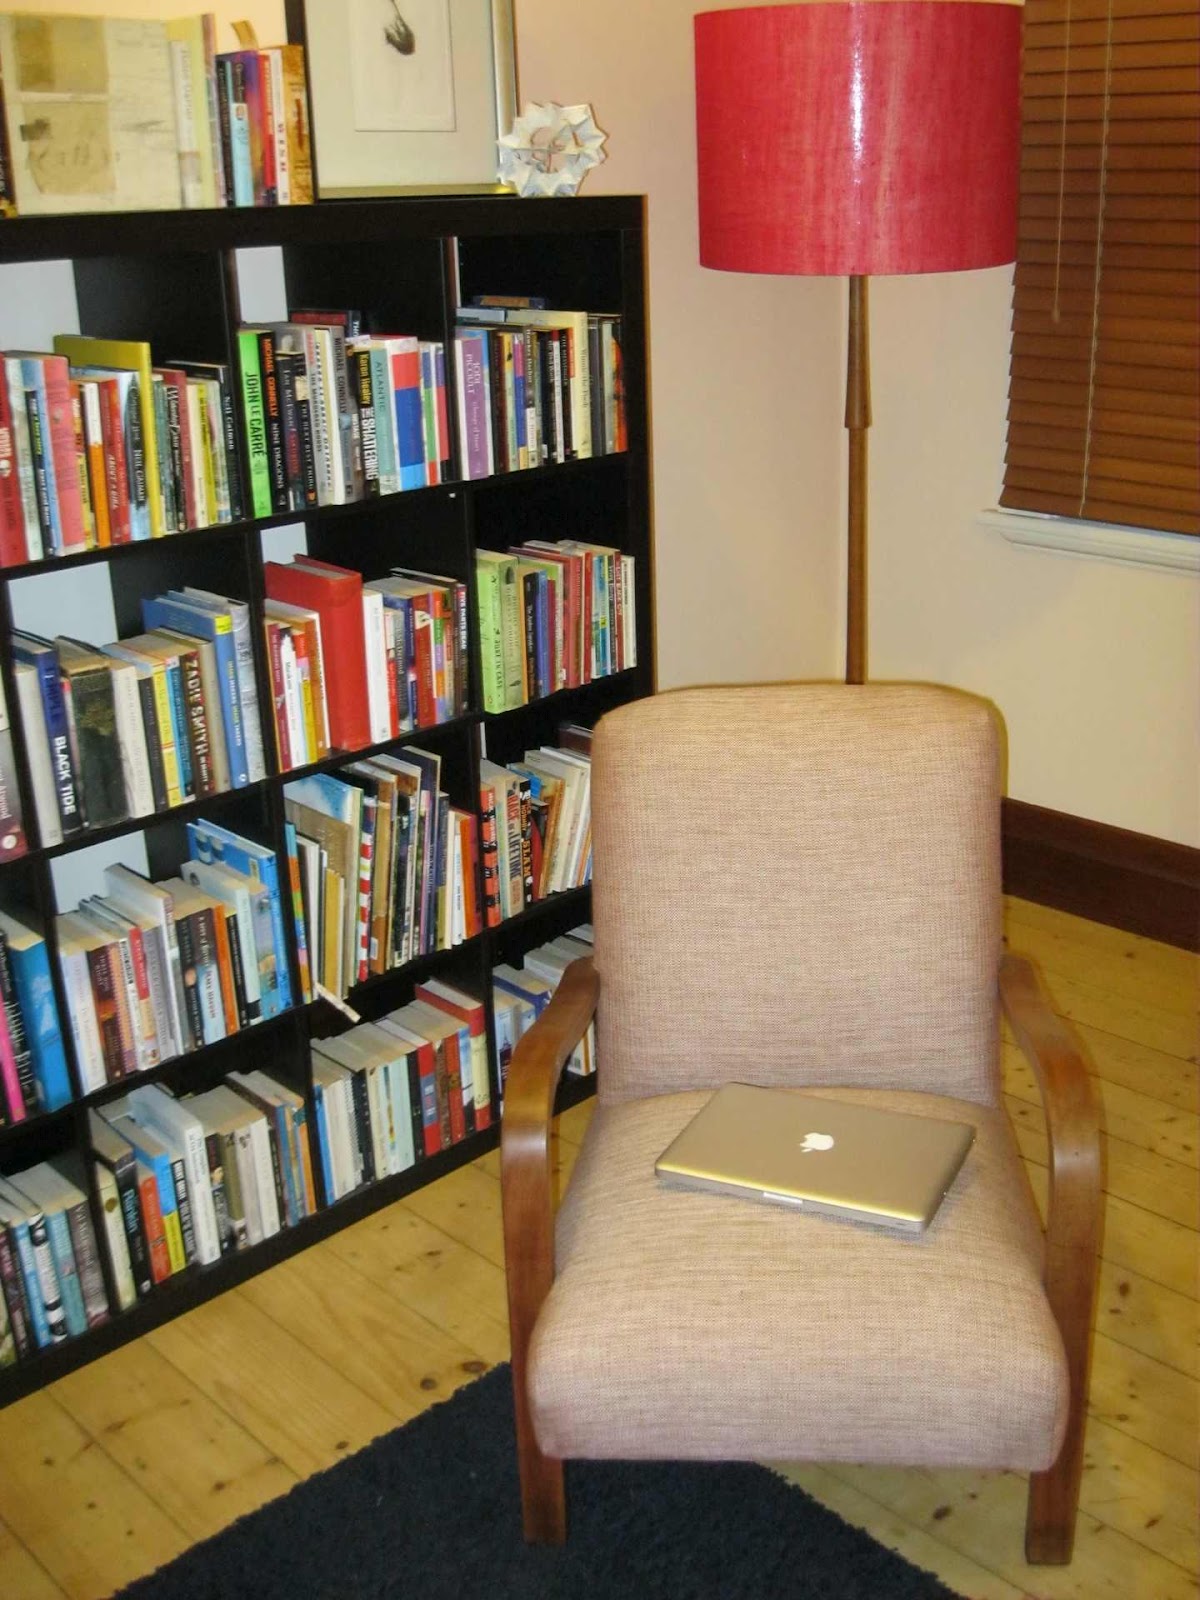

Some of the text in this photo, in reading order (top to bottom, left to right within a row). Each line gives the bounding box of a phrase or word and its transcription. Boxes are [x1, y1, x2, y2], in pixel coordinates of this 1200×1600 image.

[334, 338, 347, 414] MICHAEL CONNELLY
[359, 354, 374, 405] Karen Healey
[376, 361, 386, 411] ATLANTIC
[466, 354, 475, 395] PICOULT
[473, 361, 481, 384] JODI
[224, 396, 234, 450] Neil Gaiman
[245, 372, 267, 458] JOHN LE CARRÉ
[263, 338, 284, 489] MICHAEL CONNELLY NINE DRAGONS
[108, 454, 117, 481] ABOUT
[305, 444, 313, 462] BEST
[362, 419, 378, 480] SHATTERING
[186, 660, 203, 703] ZADIE
[190, 706, 209, 755] SMITH
[54, 735, 76, 815] BLACK TIDE
[507, 795, 520, 823] RACE
[509, 833, 521, 880] LIFETIME
[522, 840, 531, 877] SLAM
[122, 1188, 140, 1233] Rankin
